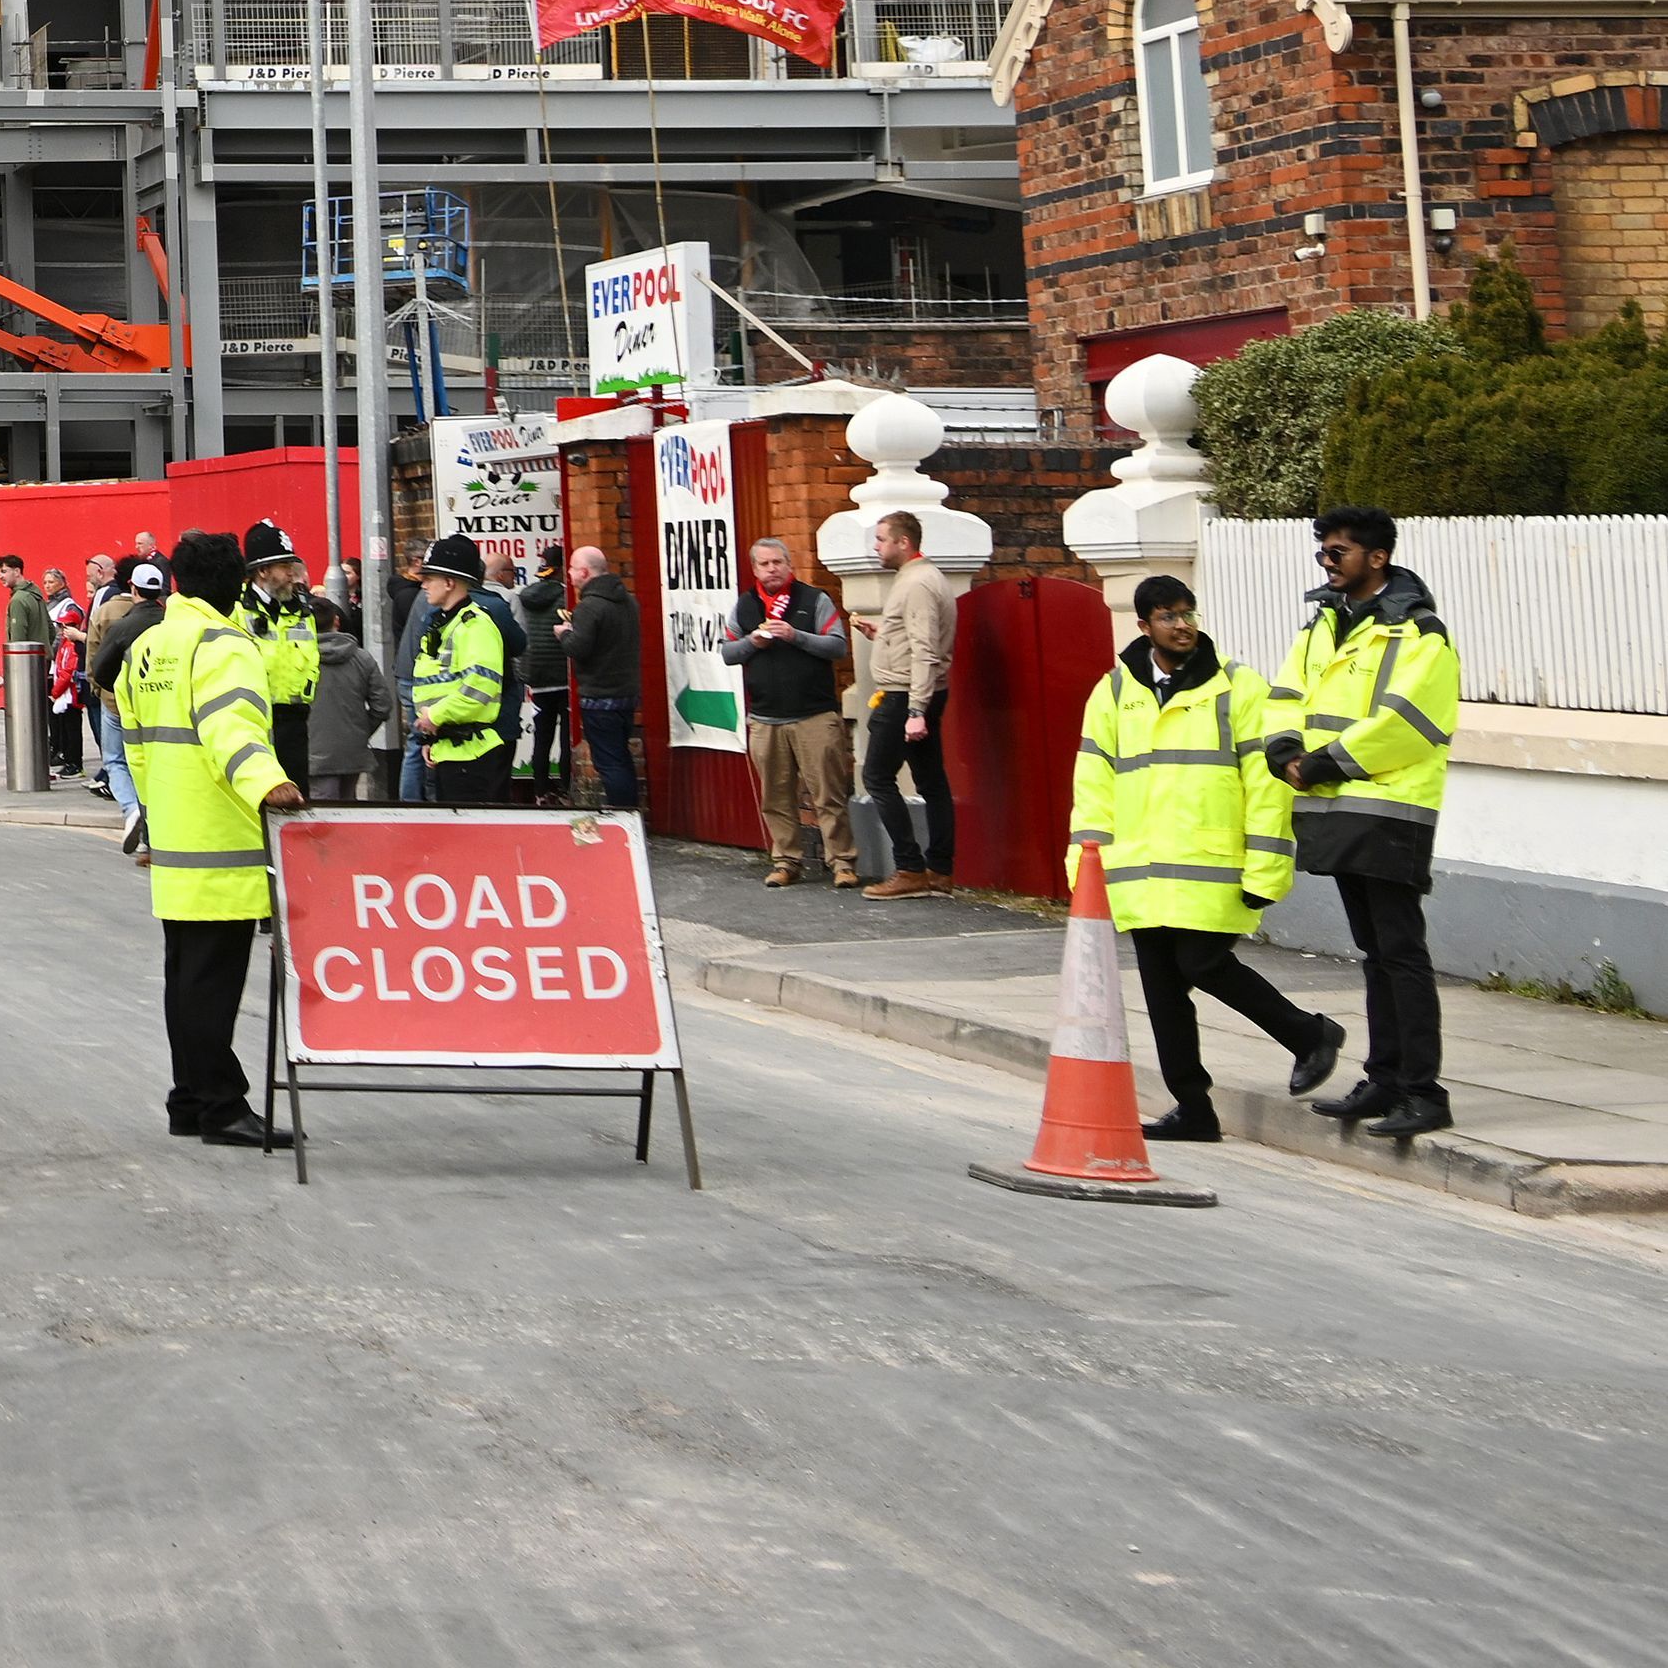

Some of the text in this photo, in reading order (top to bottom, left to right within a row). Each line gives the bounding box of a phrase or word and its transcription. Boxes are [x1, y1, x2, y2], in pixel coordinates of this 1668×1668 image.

[766, 18, 802, 43] Alone
[780, 6, 810, 31] FC
[247, 68, 311, 79] J&D Pier
[394, 68, 436, 79] Pierce
[592, 263, 681, 319] EVERPOOL
[221, 341, 294, 354] J&D Pierce
[528, 360, 557, 371] J&D
[468, 426, 521, 454] EVERPOOL
[660, 434, 727, 506] EVERPOOL
[469, 491, 532, 510] Diner
[454, 513, 561, 533] MENU
[663, 518, 730, 591] DINER
[669, 610, 727, 655] THIS WA
[351, 872, 568, 931] ROAD
[312, 944, 629, 1003] CLOSED
